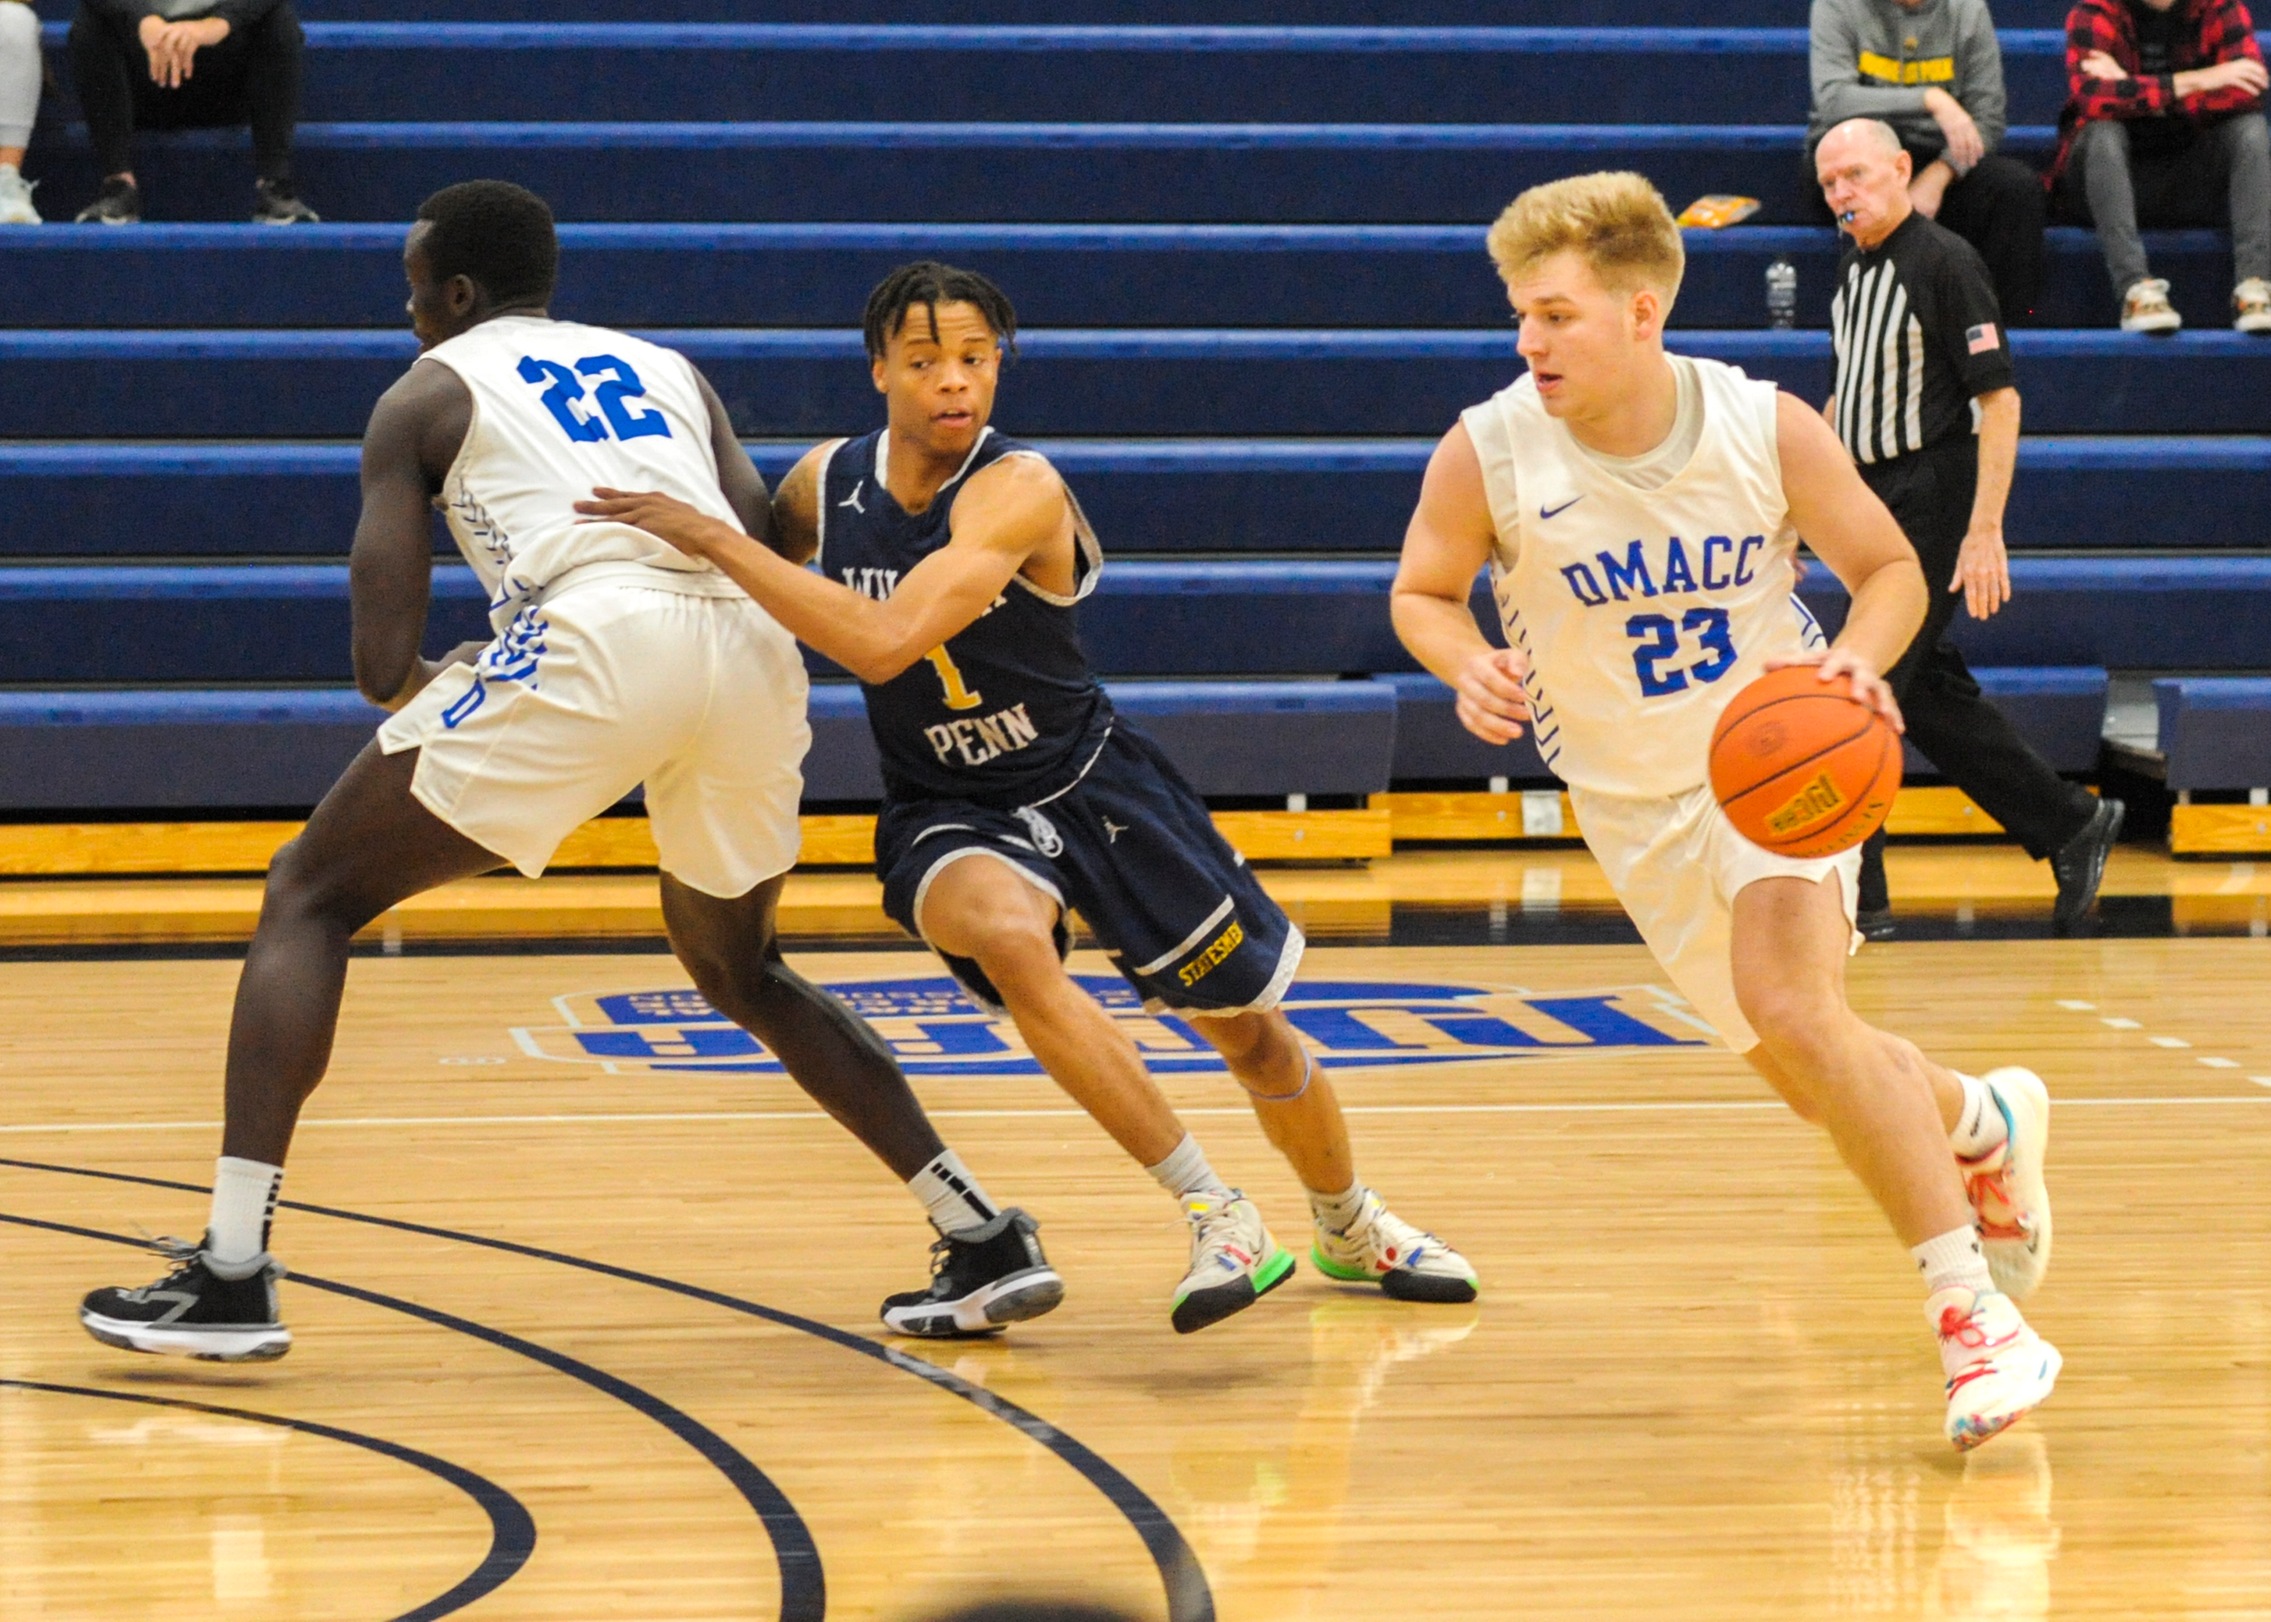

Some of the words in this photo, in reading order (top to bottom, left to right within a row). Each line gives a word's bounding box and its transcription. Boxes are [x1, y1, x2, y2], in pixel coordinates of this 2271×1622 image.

[516, 354, 673, 443] 22
[1559, 534, 1765, 607] DMACC
[924, 643, 983, 710] 1
[1625, 607, 1738, 697] 23
[923, 702, 1039, 766] PENN
